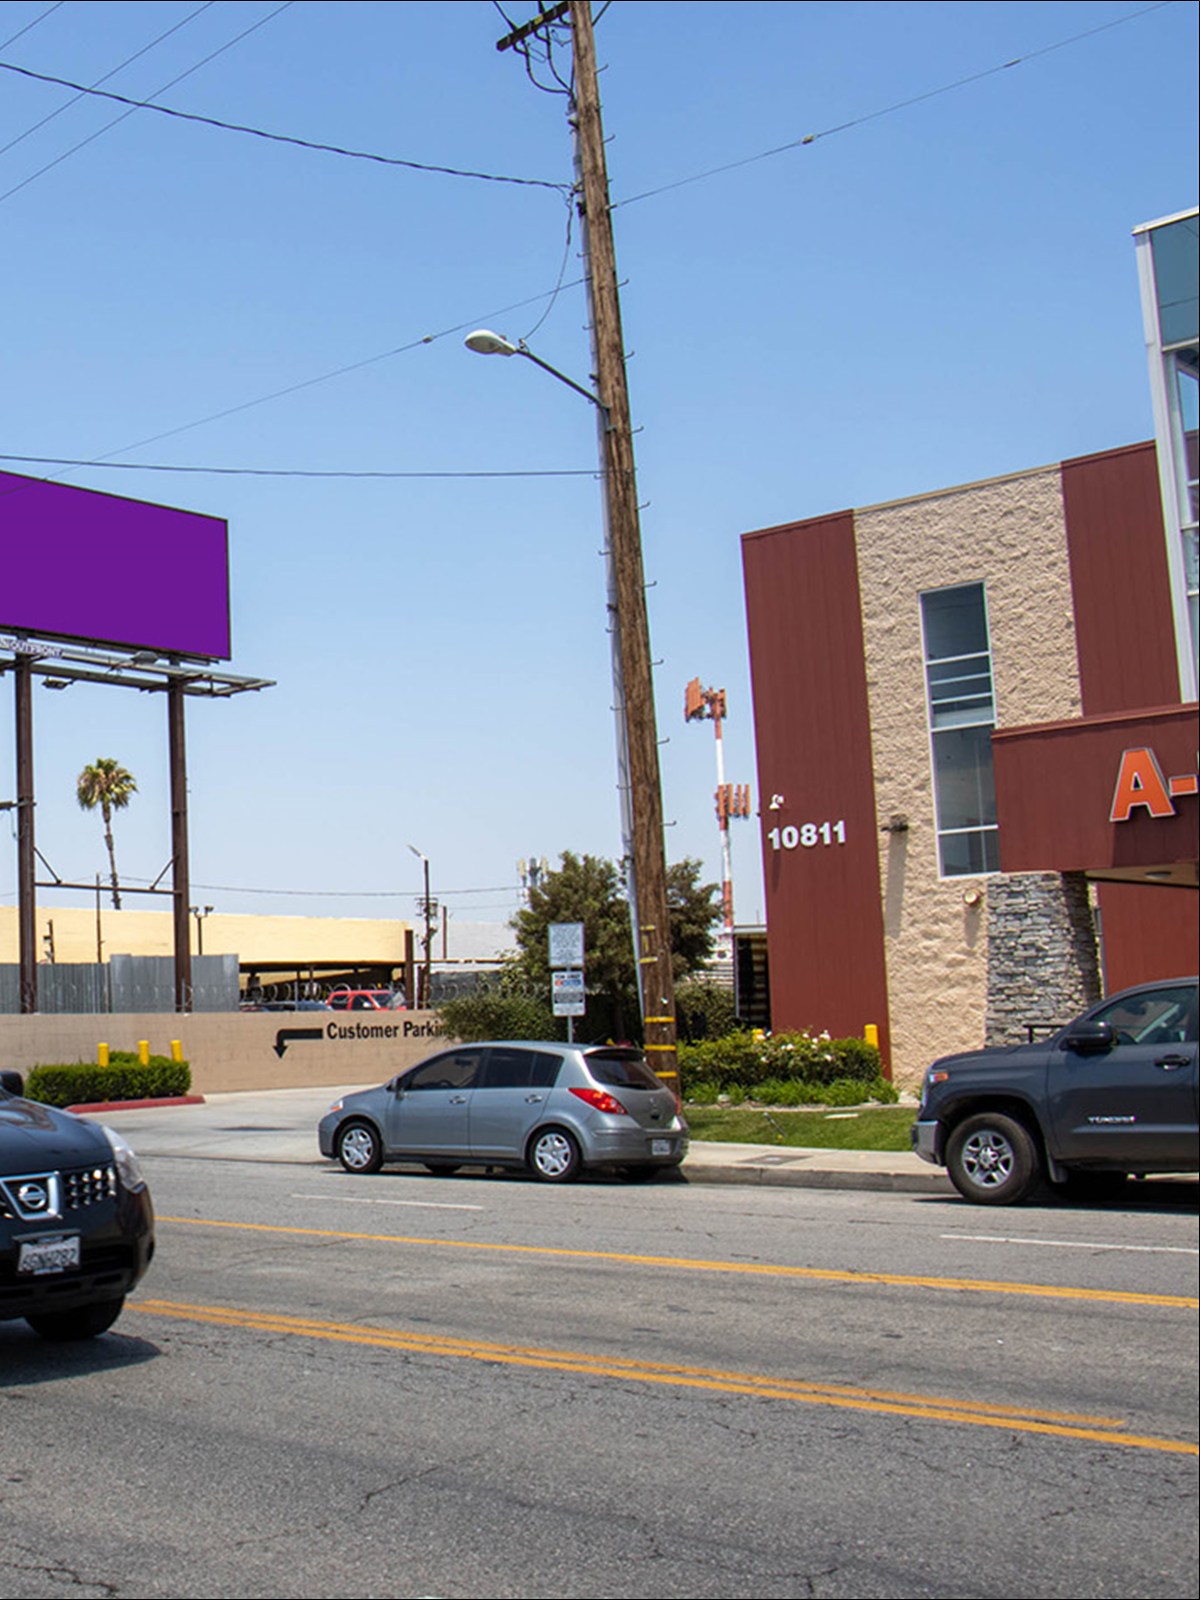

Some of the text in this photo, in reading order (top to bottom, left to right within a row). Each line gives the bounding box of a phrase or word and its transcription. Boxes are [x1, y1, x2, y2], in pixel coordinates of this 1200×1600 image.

[1109, 746, 1199, 823] A-
[767, 820, 846, 850] 10811
[327, 1022, 400, 1039] Customer
